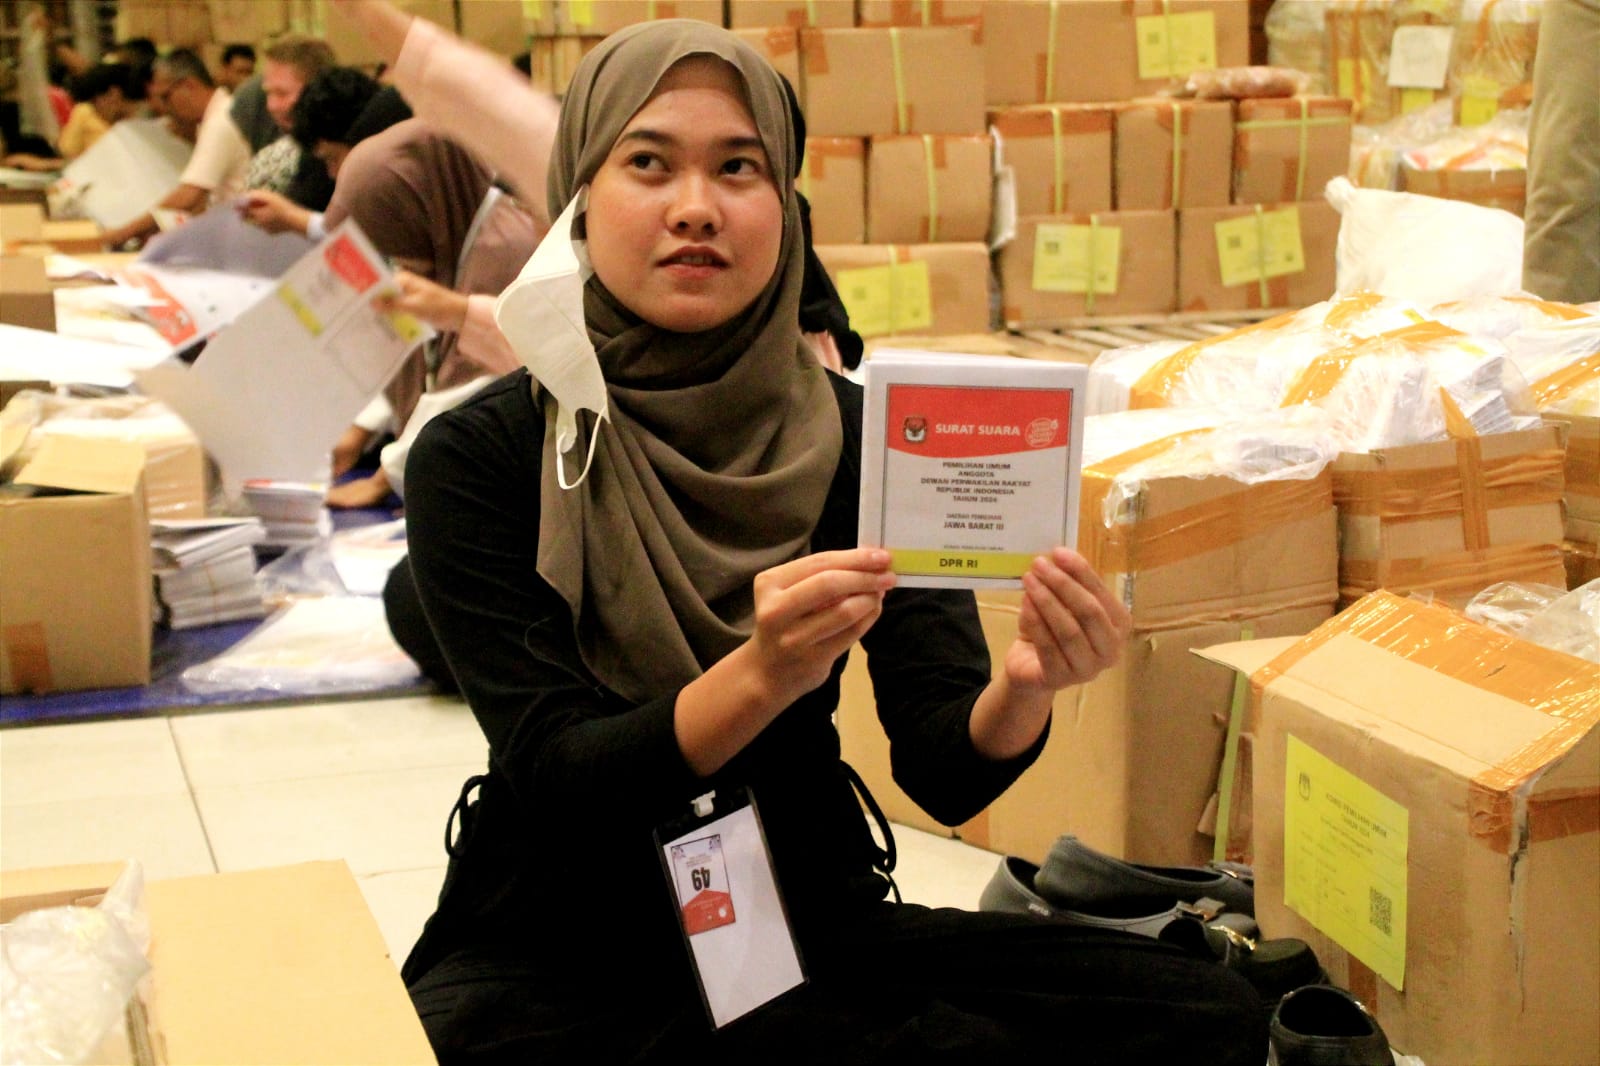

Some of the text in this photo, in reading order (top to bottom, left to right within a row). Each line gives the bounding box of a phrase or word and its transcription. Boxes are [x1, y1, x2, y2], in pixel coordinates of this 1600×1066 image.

[935, 423, 975, 434] SURAT
[978, 425, 1020, 436] SUARA
[942, 462, 1011, 470] PEMILIHAN UMUM
[958, 470, 995, 478] ANGGOTA
[920, 477, 1031, 488] DEWAN PERWAKILAN RAKYAT
[936, 486, 1015, 495] REPUBLIK INDONESIA
[953, 495, 978, 503] TAHUN
[943, 521, 966, 529] JAWA
[968, 522, 994, 530] BARAT
[939, 558, 978, 568] DPR RI
[692, 867, 710, 892] 49
